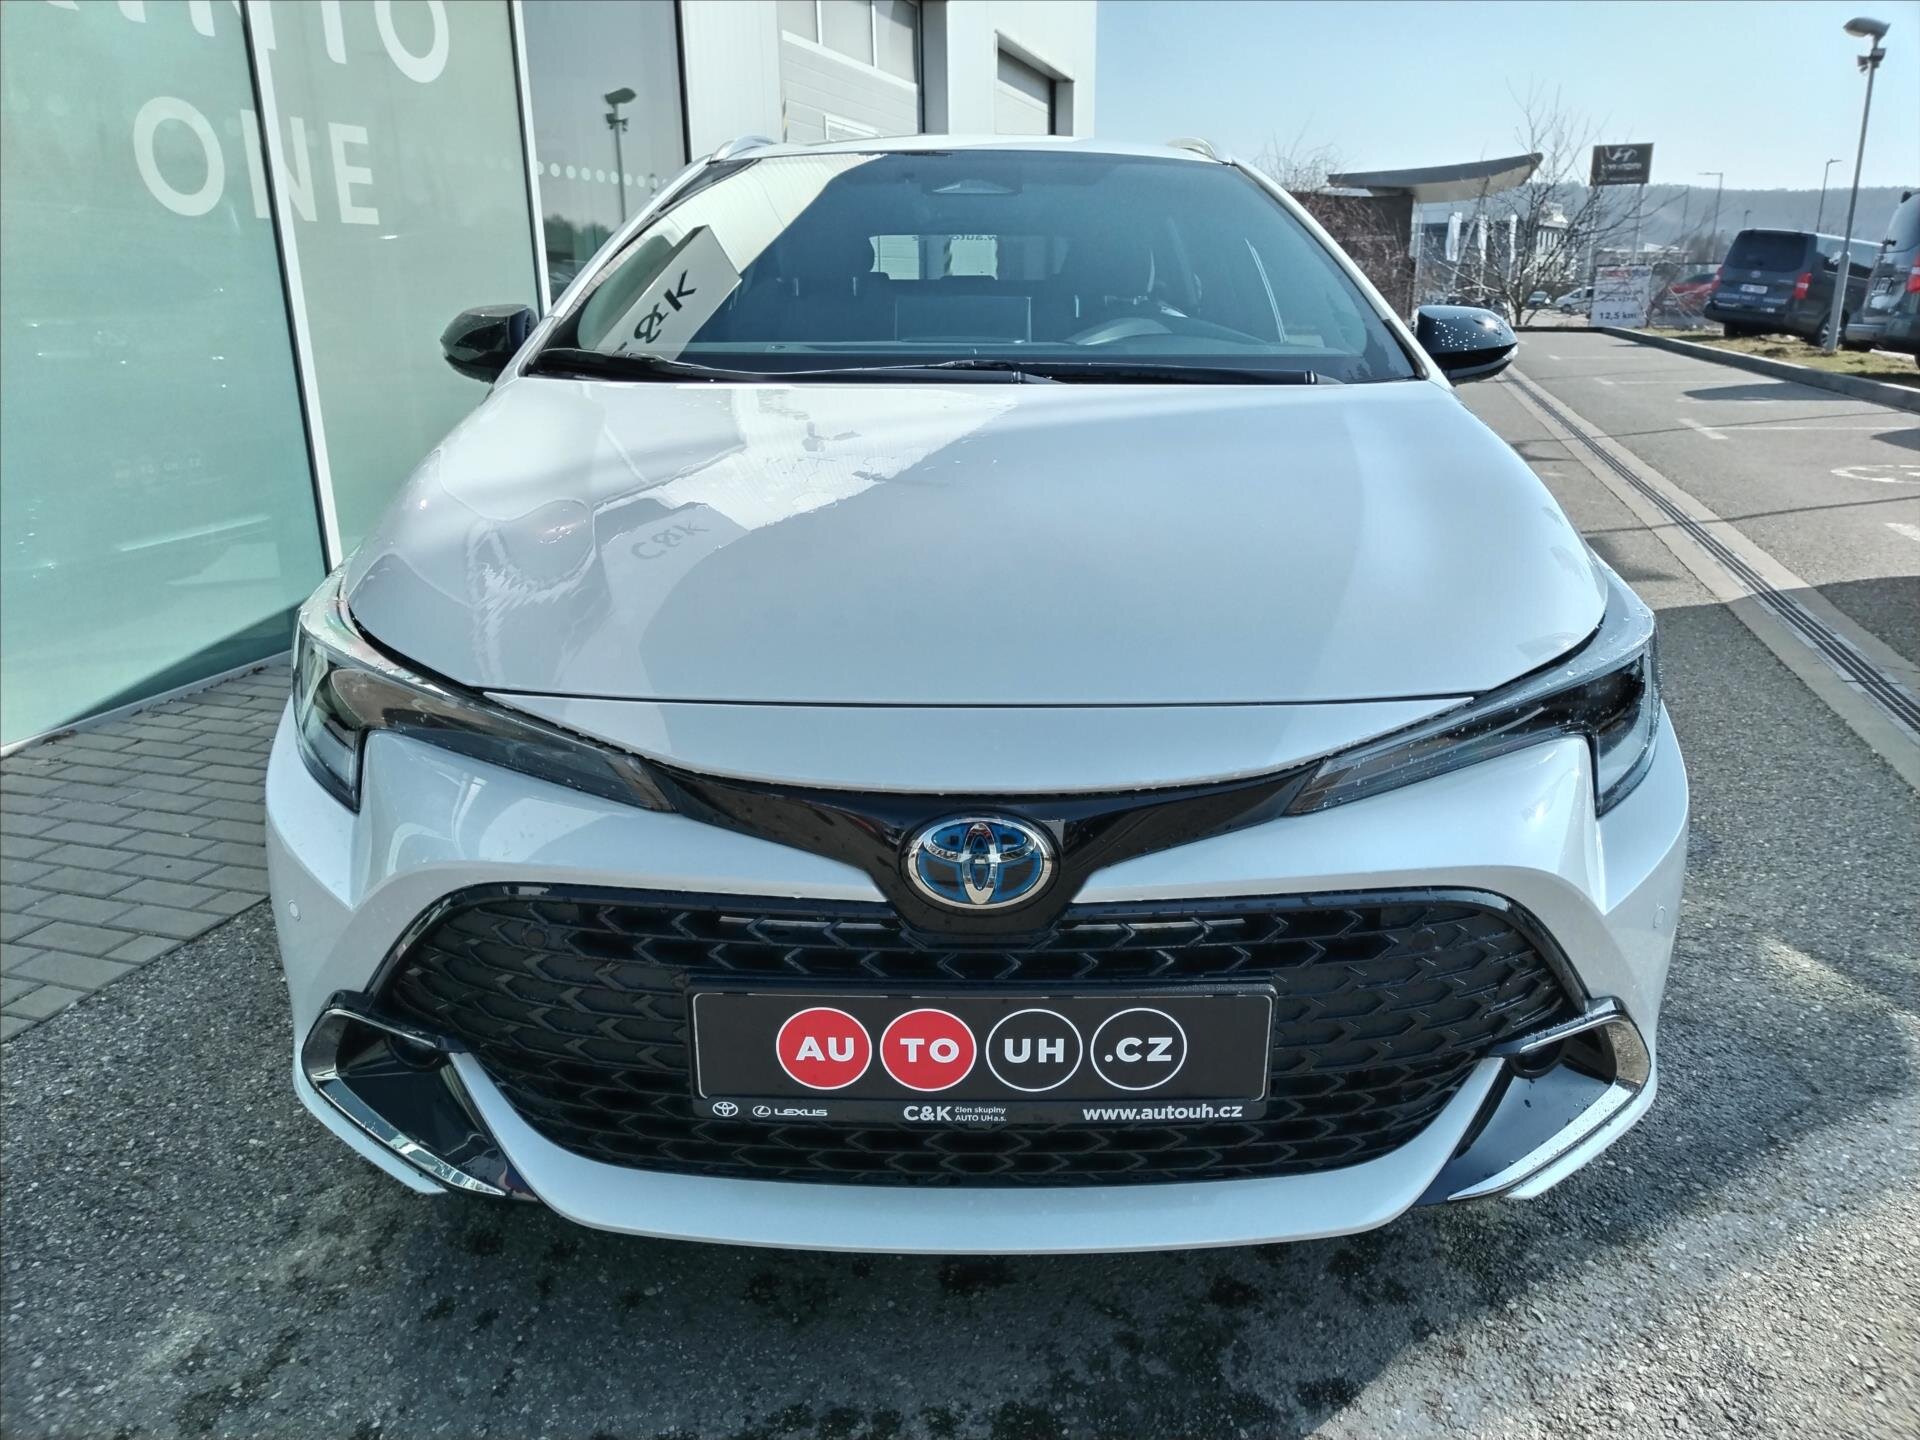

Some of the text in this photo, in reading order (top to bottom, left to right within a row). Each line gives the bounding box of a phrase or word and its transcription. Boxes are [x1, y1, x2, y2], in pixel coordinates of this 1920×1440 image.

[133, 95, 380, 225] ONE
[1600, 311, 1620, 320] 12,5
[796, 1036, 1173, 1063] AU TO UH .CZ
[774, 1108, 828, 1117] LEXUS
[903, 1105, 953, 1121] C&K
[954, 1106, 1007, 1115] člen skupiny
[1082, 1104, 1243, 1121] www.autouh.cz
